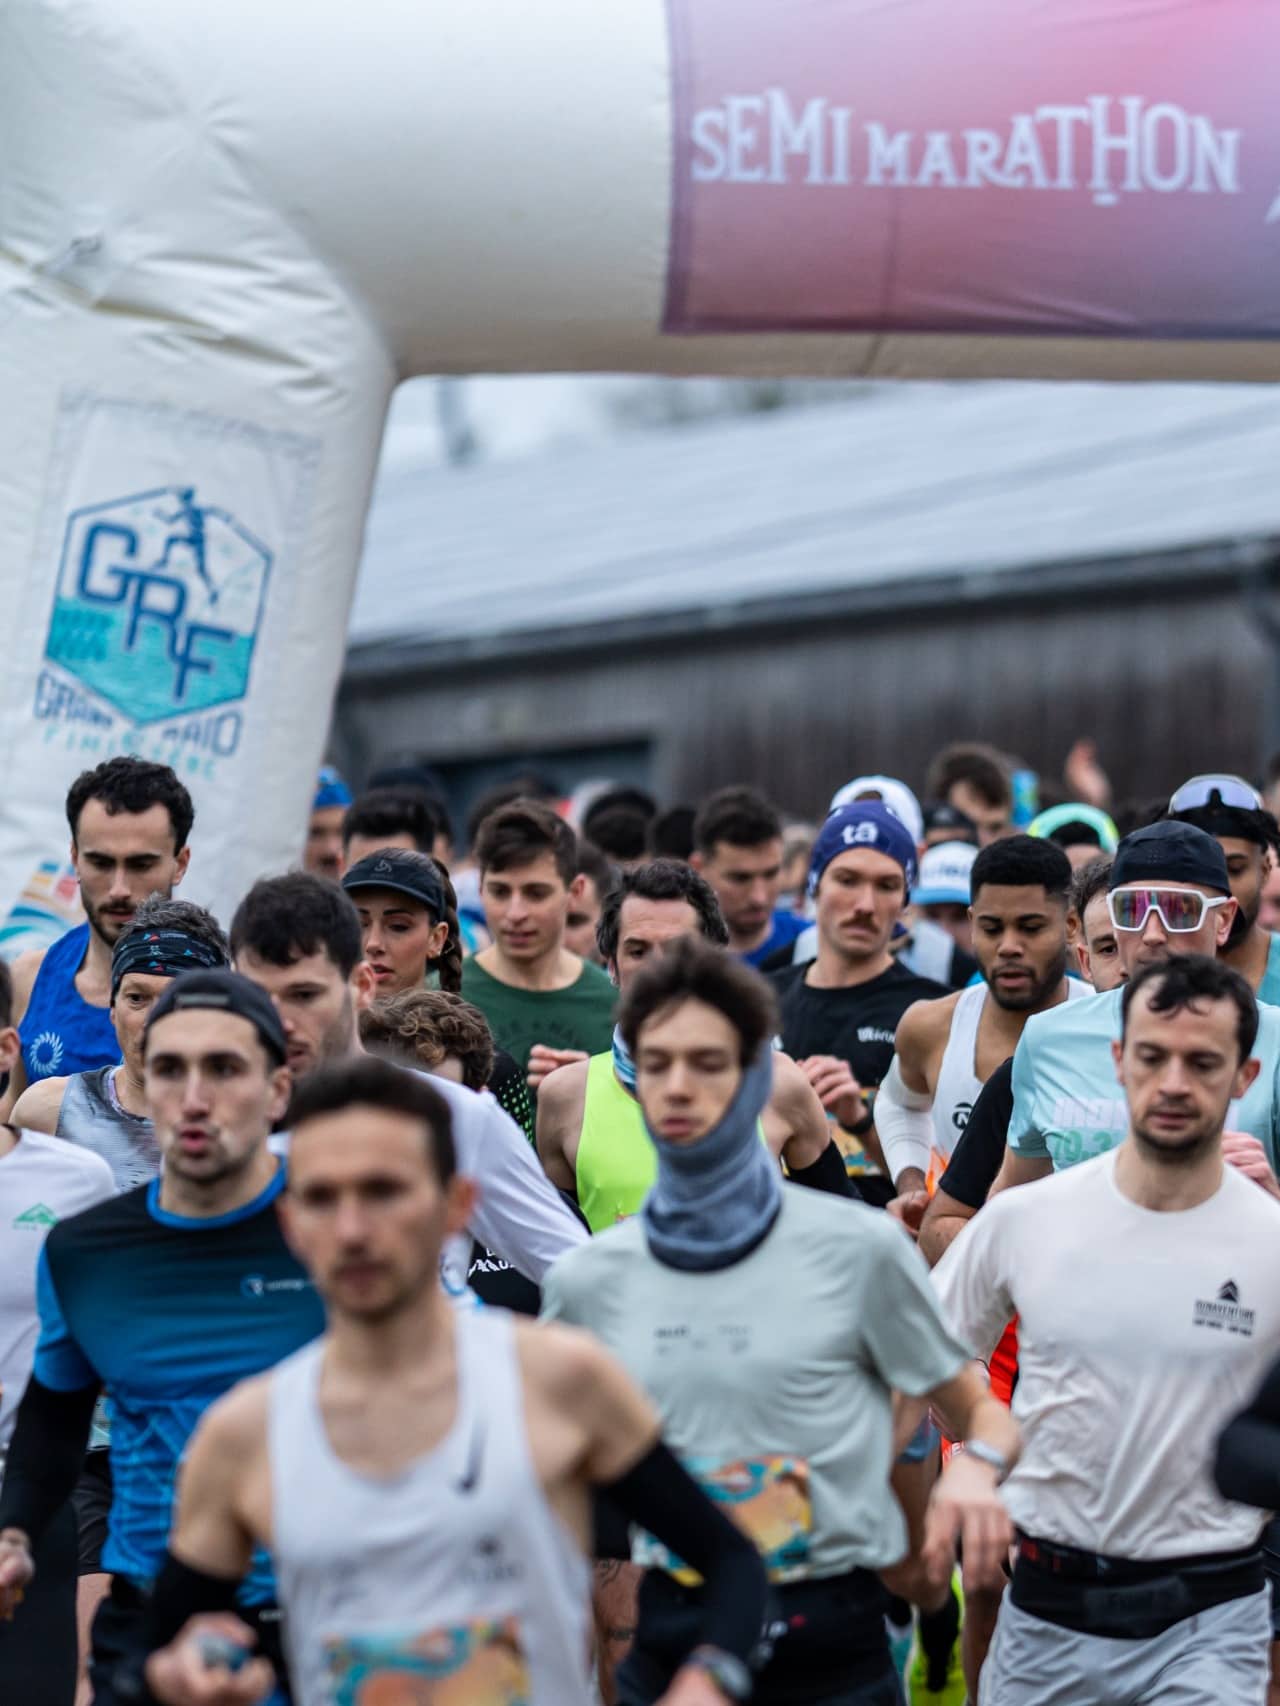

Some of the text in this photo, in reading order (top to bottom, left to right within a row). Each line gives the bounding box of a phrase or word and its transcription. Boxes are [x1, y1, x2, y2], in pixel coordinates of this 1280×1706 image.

[690, 87, 853, 184] SEMI
[865, 94, 1243, 200] MARATHON
[78, 519, 235, 702] GRF
